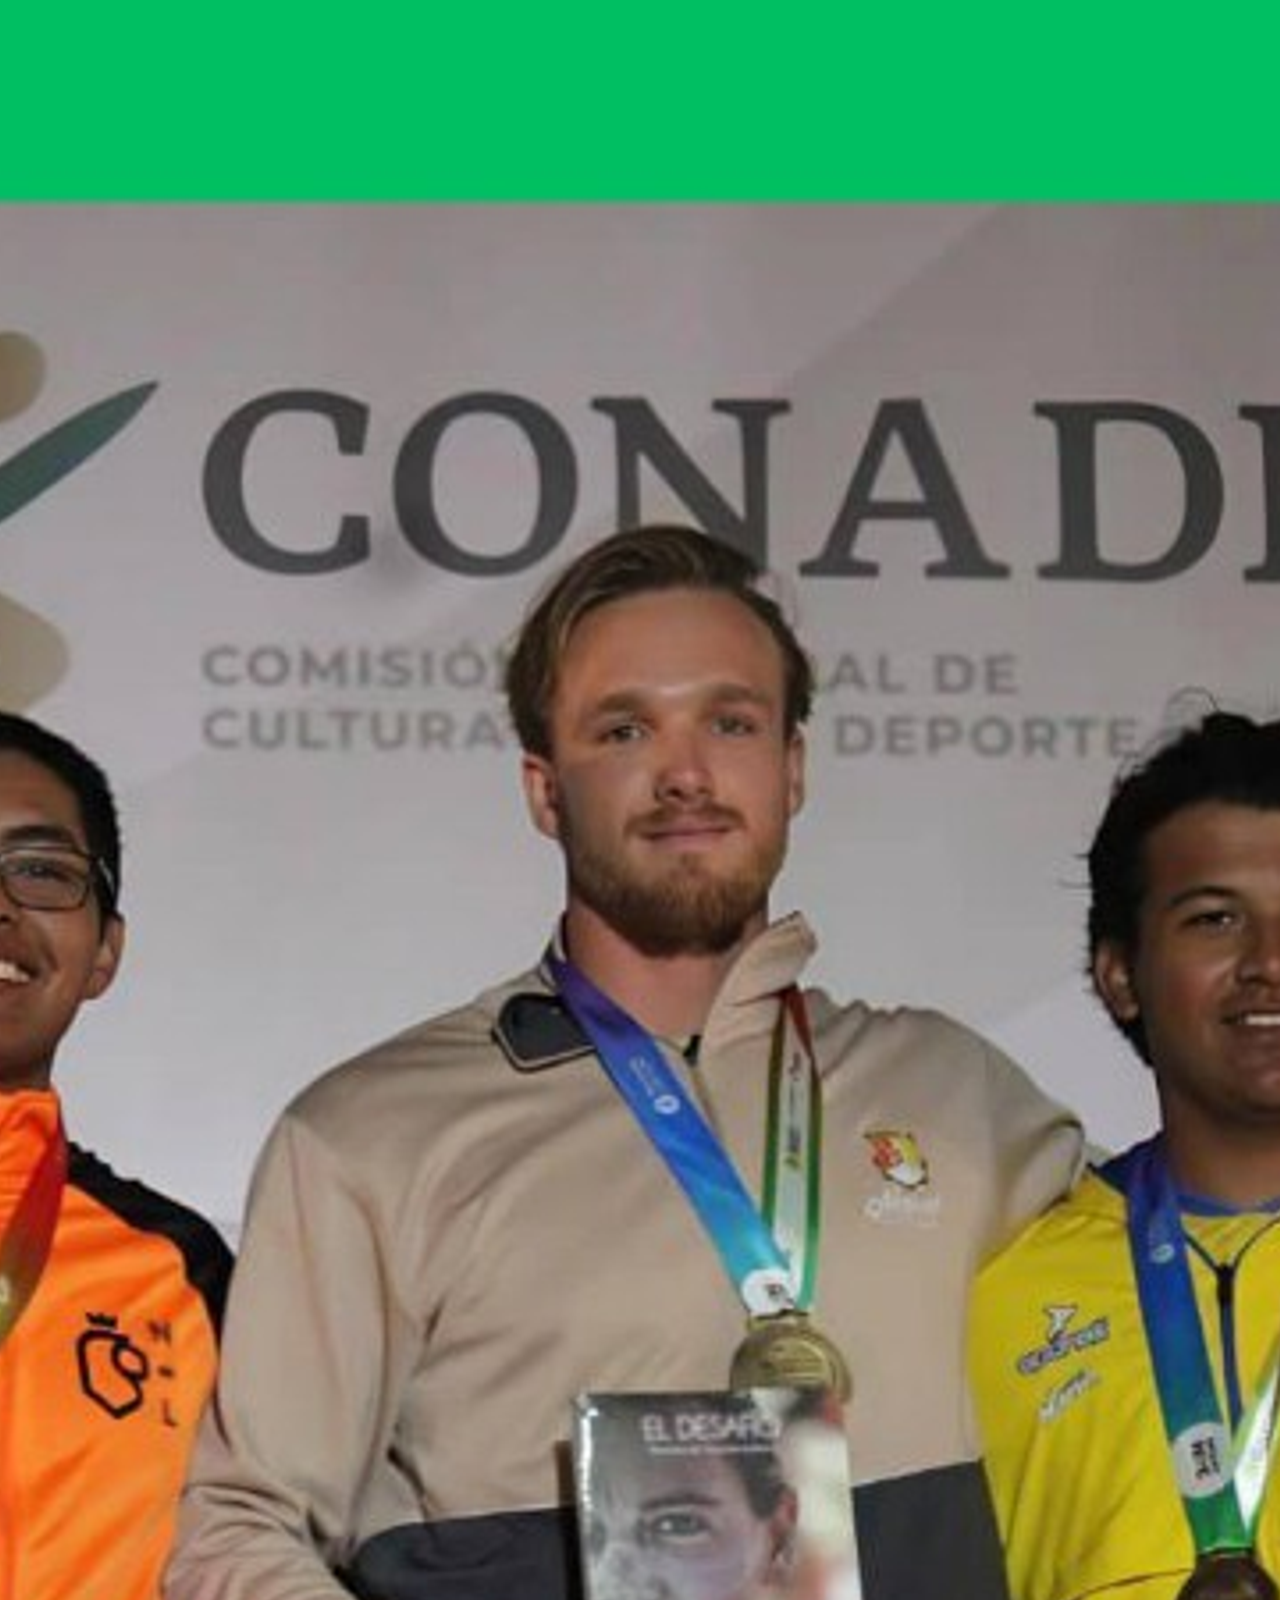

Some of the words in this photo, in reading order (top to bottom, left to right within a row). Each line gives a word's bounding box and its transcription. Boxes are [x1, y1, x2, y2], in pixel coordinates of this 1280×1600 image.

[933, 654, 1018, 694] DE
[200, 707, 505, 752] CULTURA
[834, 714, 1140, 759] DEPORTE
